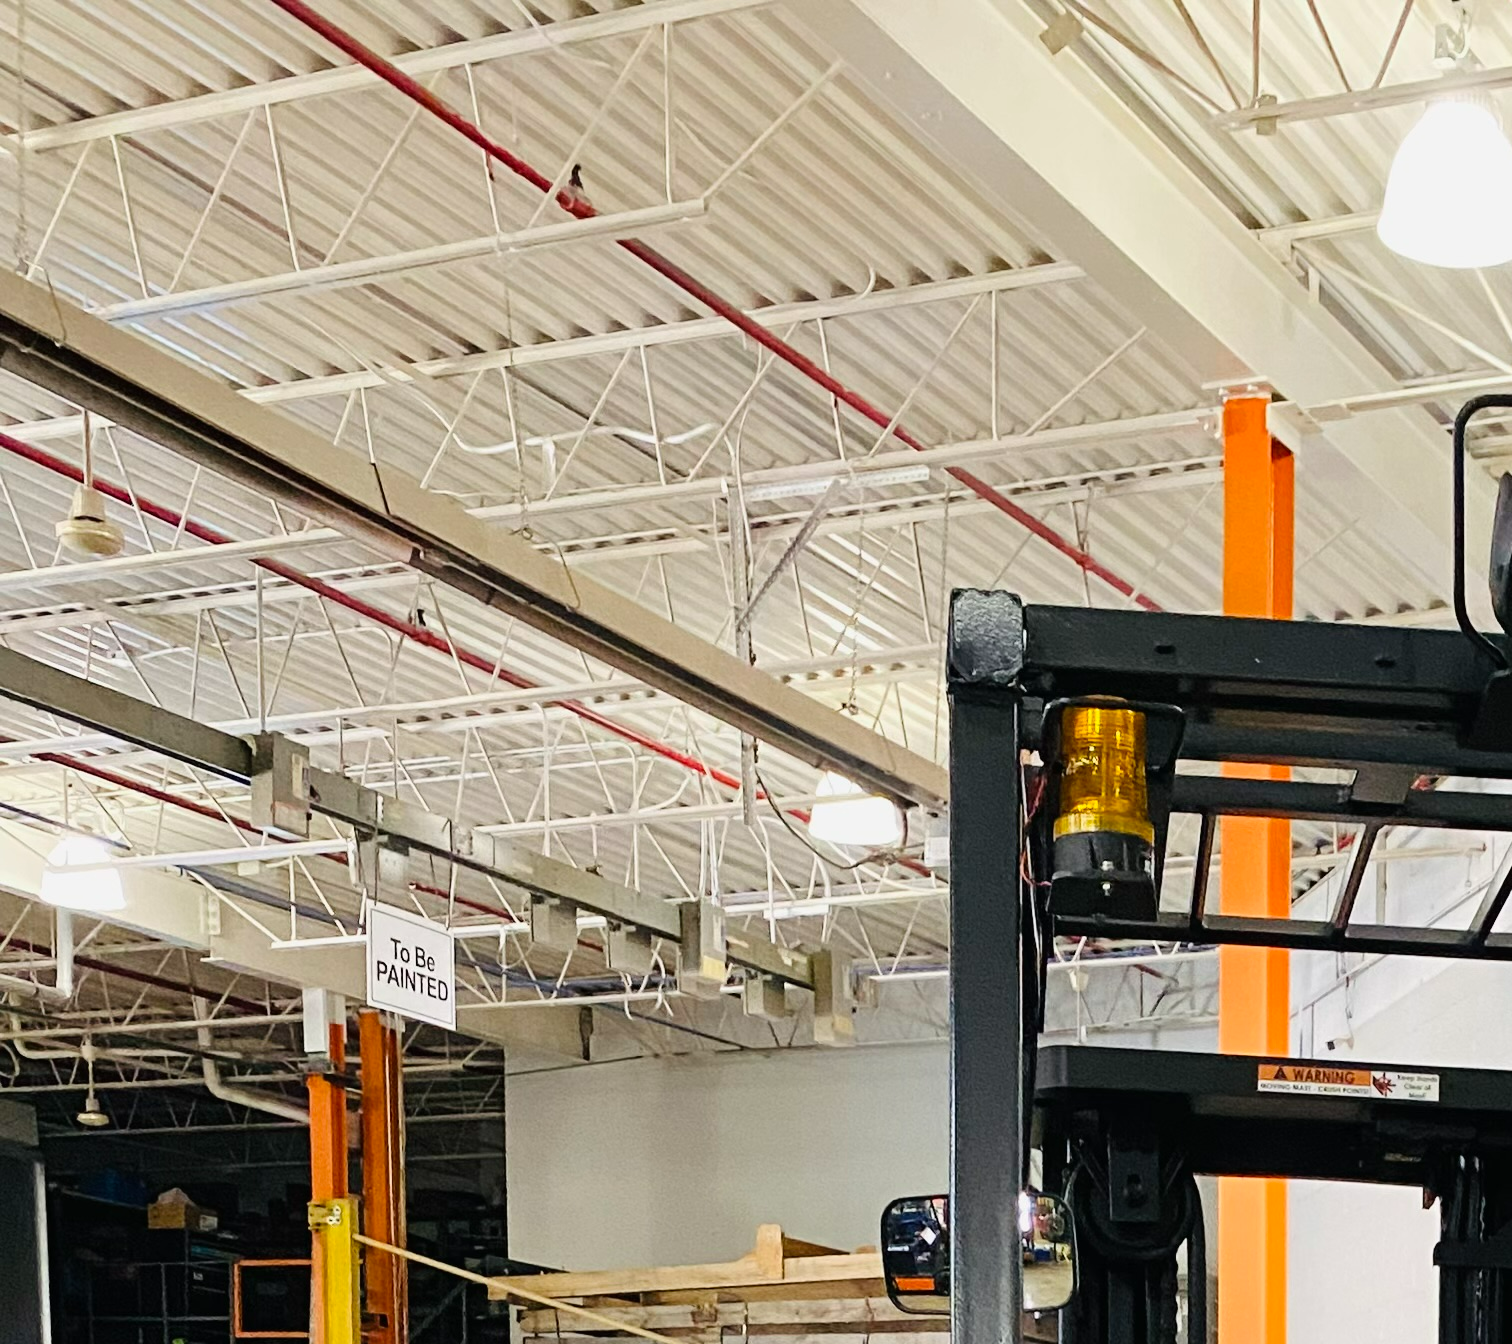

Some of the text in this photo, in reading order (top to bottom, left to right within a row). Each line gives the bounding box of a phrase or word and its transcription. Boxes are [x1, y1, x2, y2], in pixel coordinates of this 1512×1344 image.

[390, 937, 436, 972] To Be
[376, 960, 448, 1001] PAINTED
[1292, 1068, 1356, 1084] WARNING
